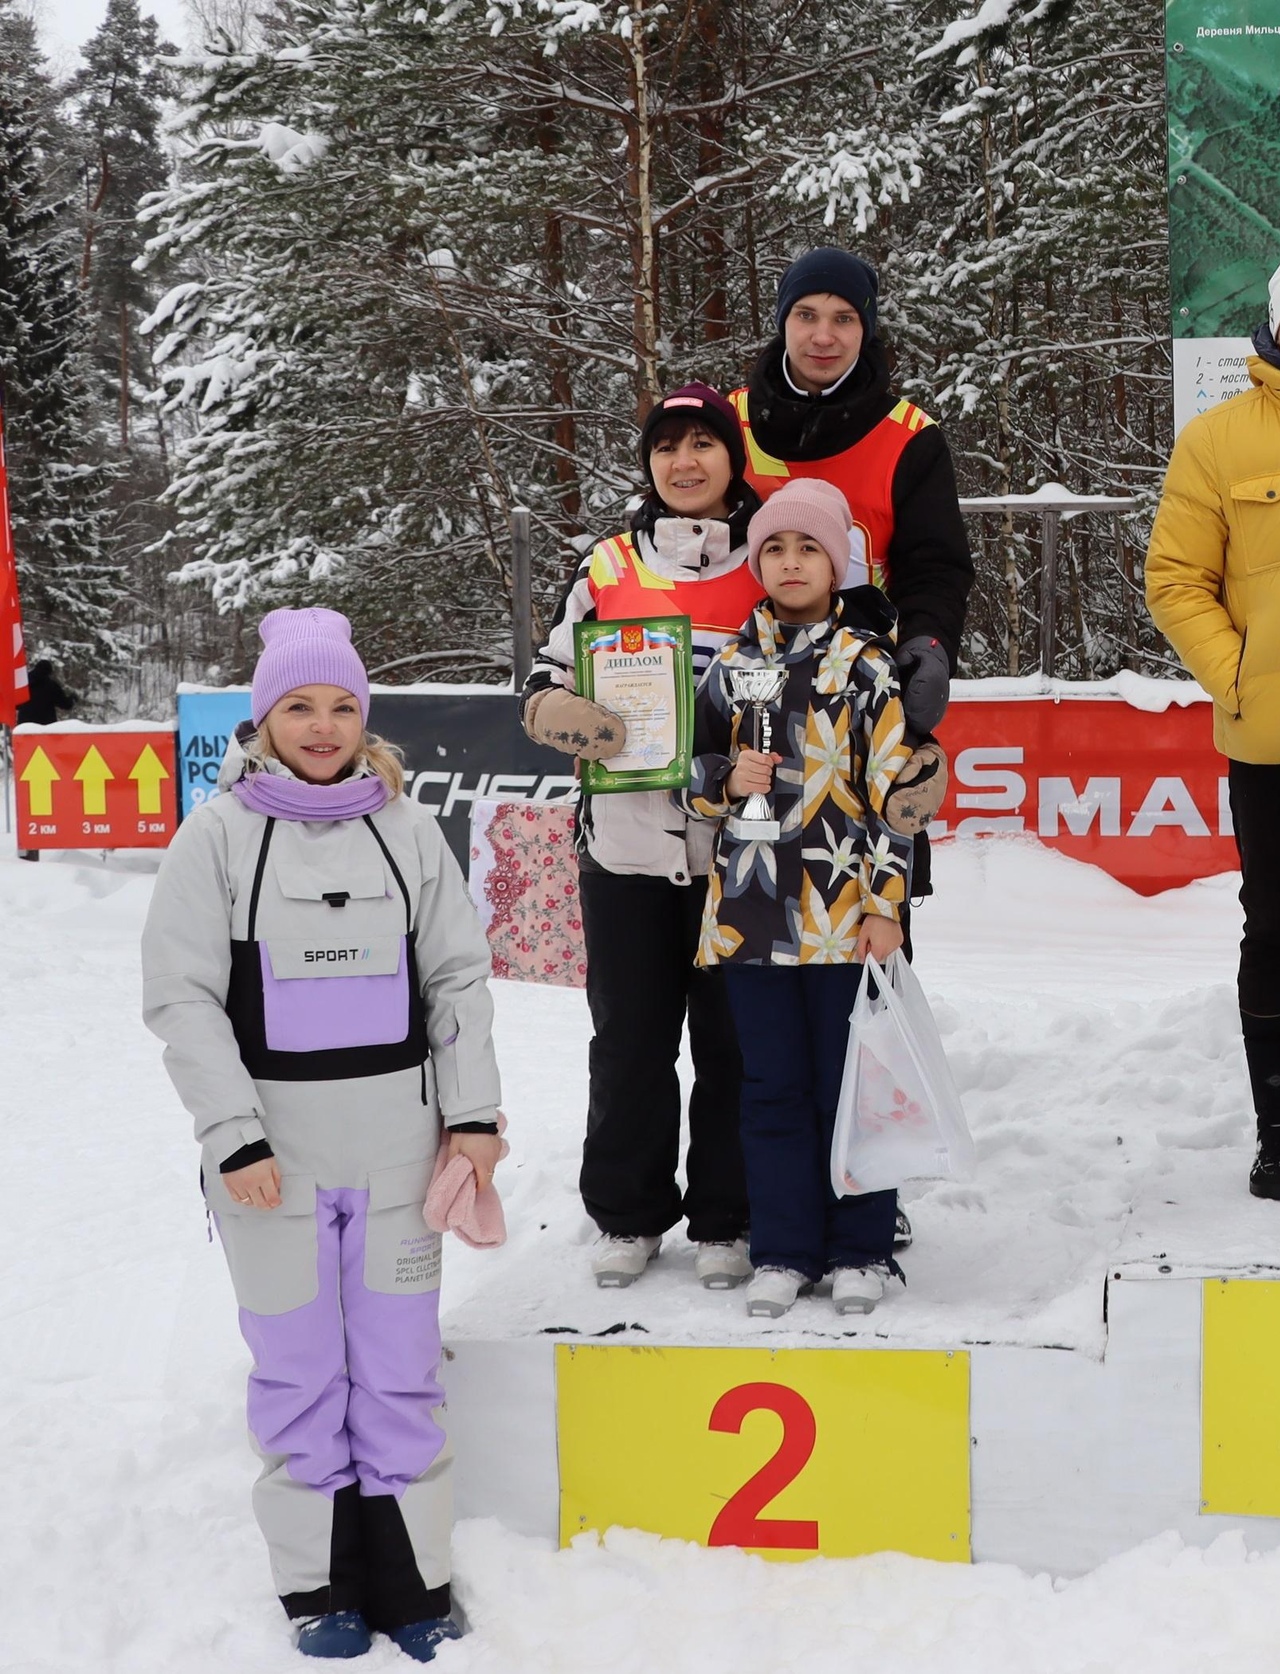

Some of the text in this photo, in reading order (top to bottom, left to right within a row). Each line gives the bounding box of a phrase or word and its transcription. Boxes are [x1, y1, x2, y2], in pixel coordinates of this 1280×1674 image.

[1197, 27, 1242, 37] Деревня
[1196, 357, 1202, 368] 1
[1196, 373, 1204, 384] 2
[604, 656, 662, 670] ДИПЛОМ
[28, 822, 37, 835] 2
[82, 822, 91, 834] 3
[138, 821, 146, 833] 5
[304, 949, 358, 962] SPORT
[396, 1253, 432, 1266] ORIGINAL
[395, 1274, 424, 1283] PLANET
[708, 1382, 819, 1550] 2
